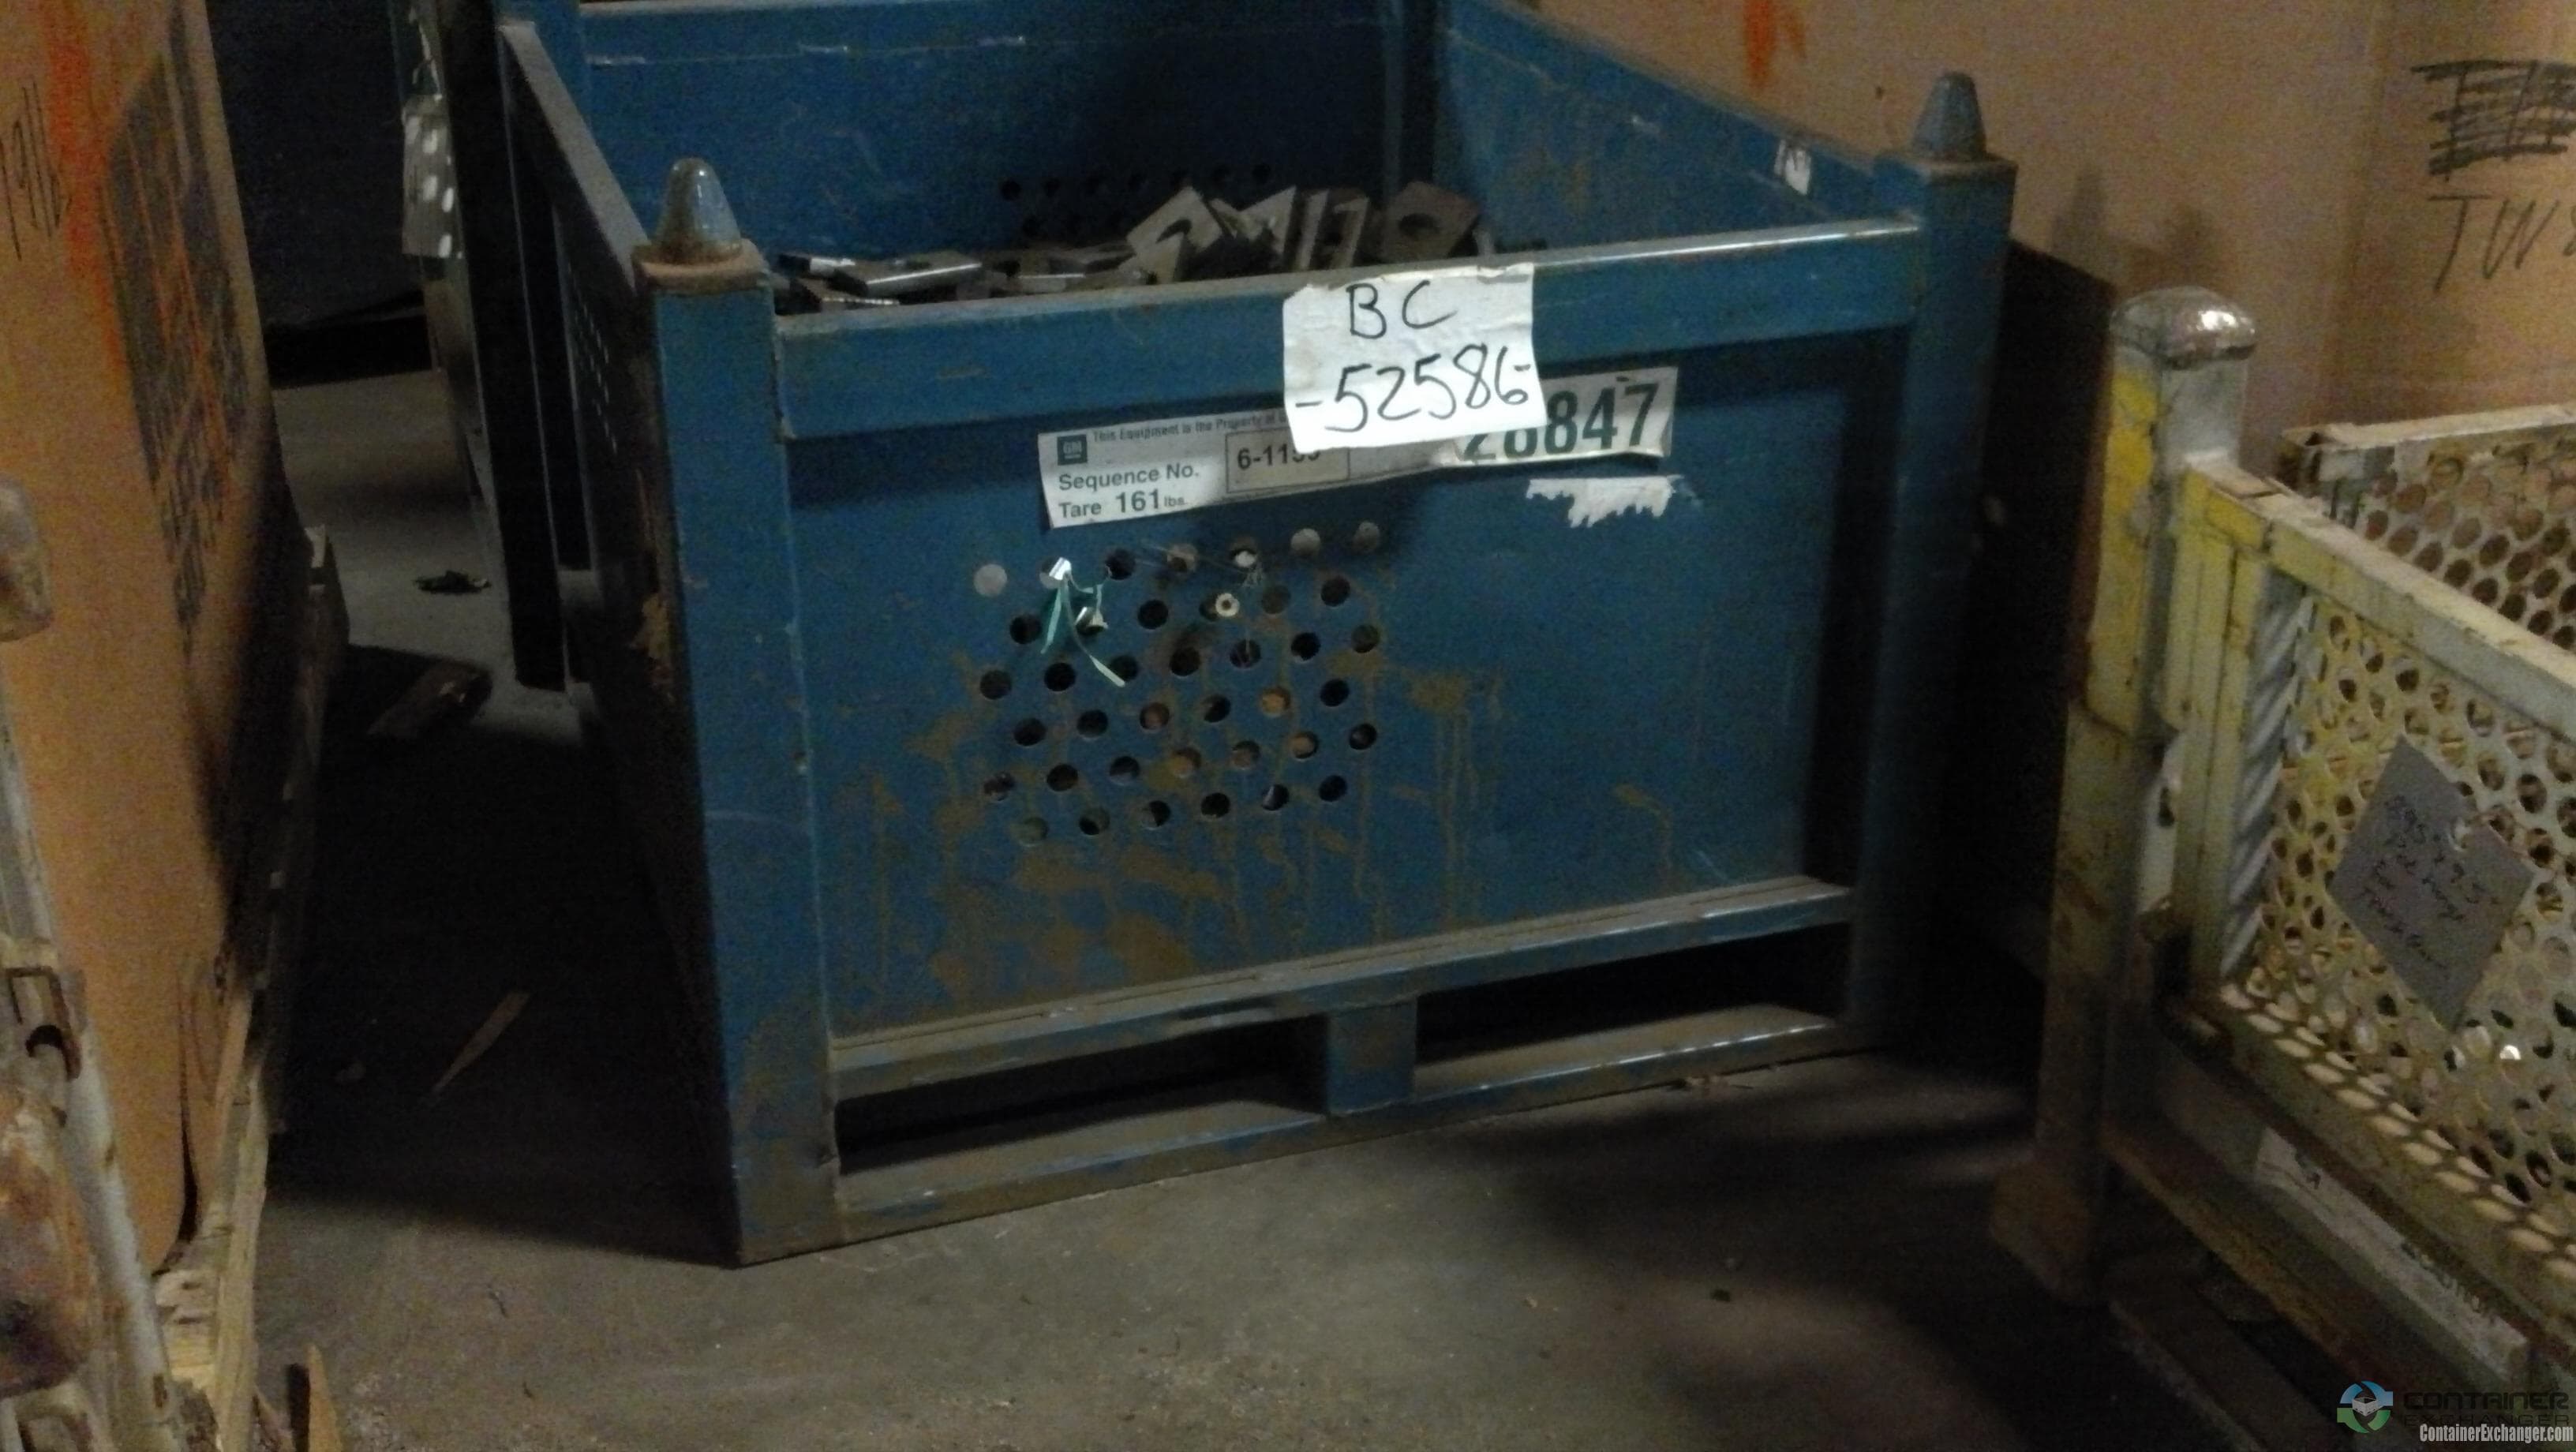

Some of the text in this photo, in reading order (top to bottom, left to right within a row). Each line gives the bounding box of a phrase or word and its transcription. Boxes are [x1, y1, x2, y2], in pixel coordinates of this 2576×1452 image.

[1120, 424, 1179, 441] Equipment
[1195, 420, 1213, 432] the
[1058, 462, 1200, 492] Sequence No.
[1058, 501, 1102, 519] Tare
[1115, 488, 1159, 514] 161
